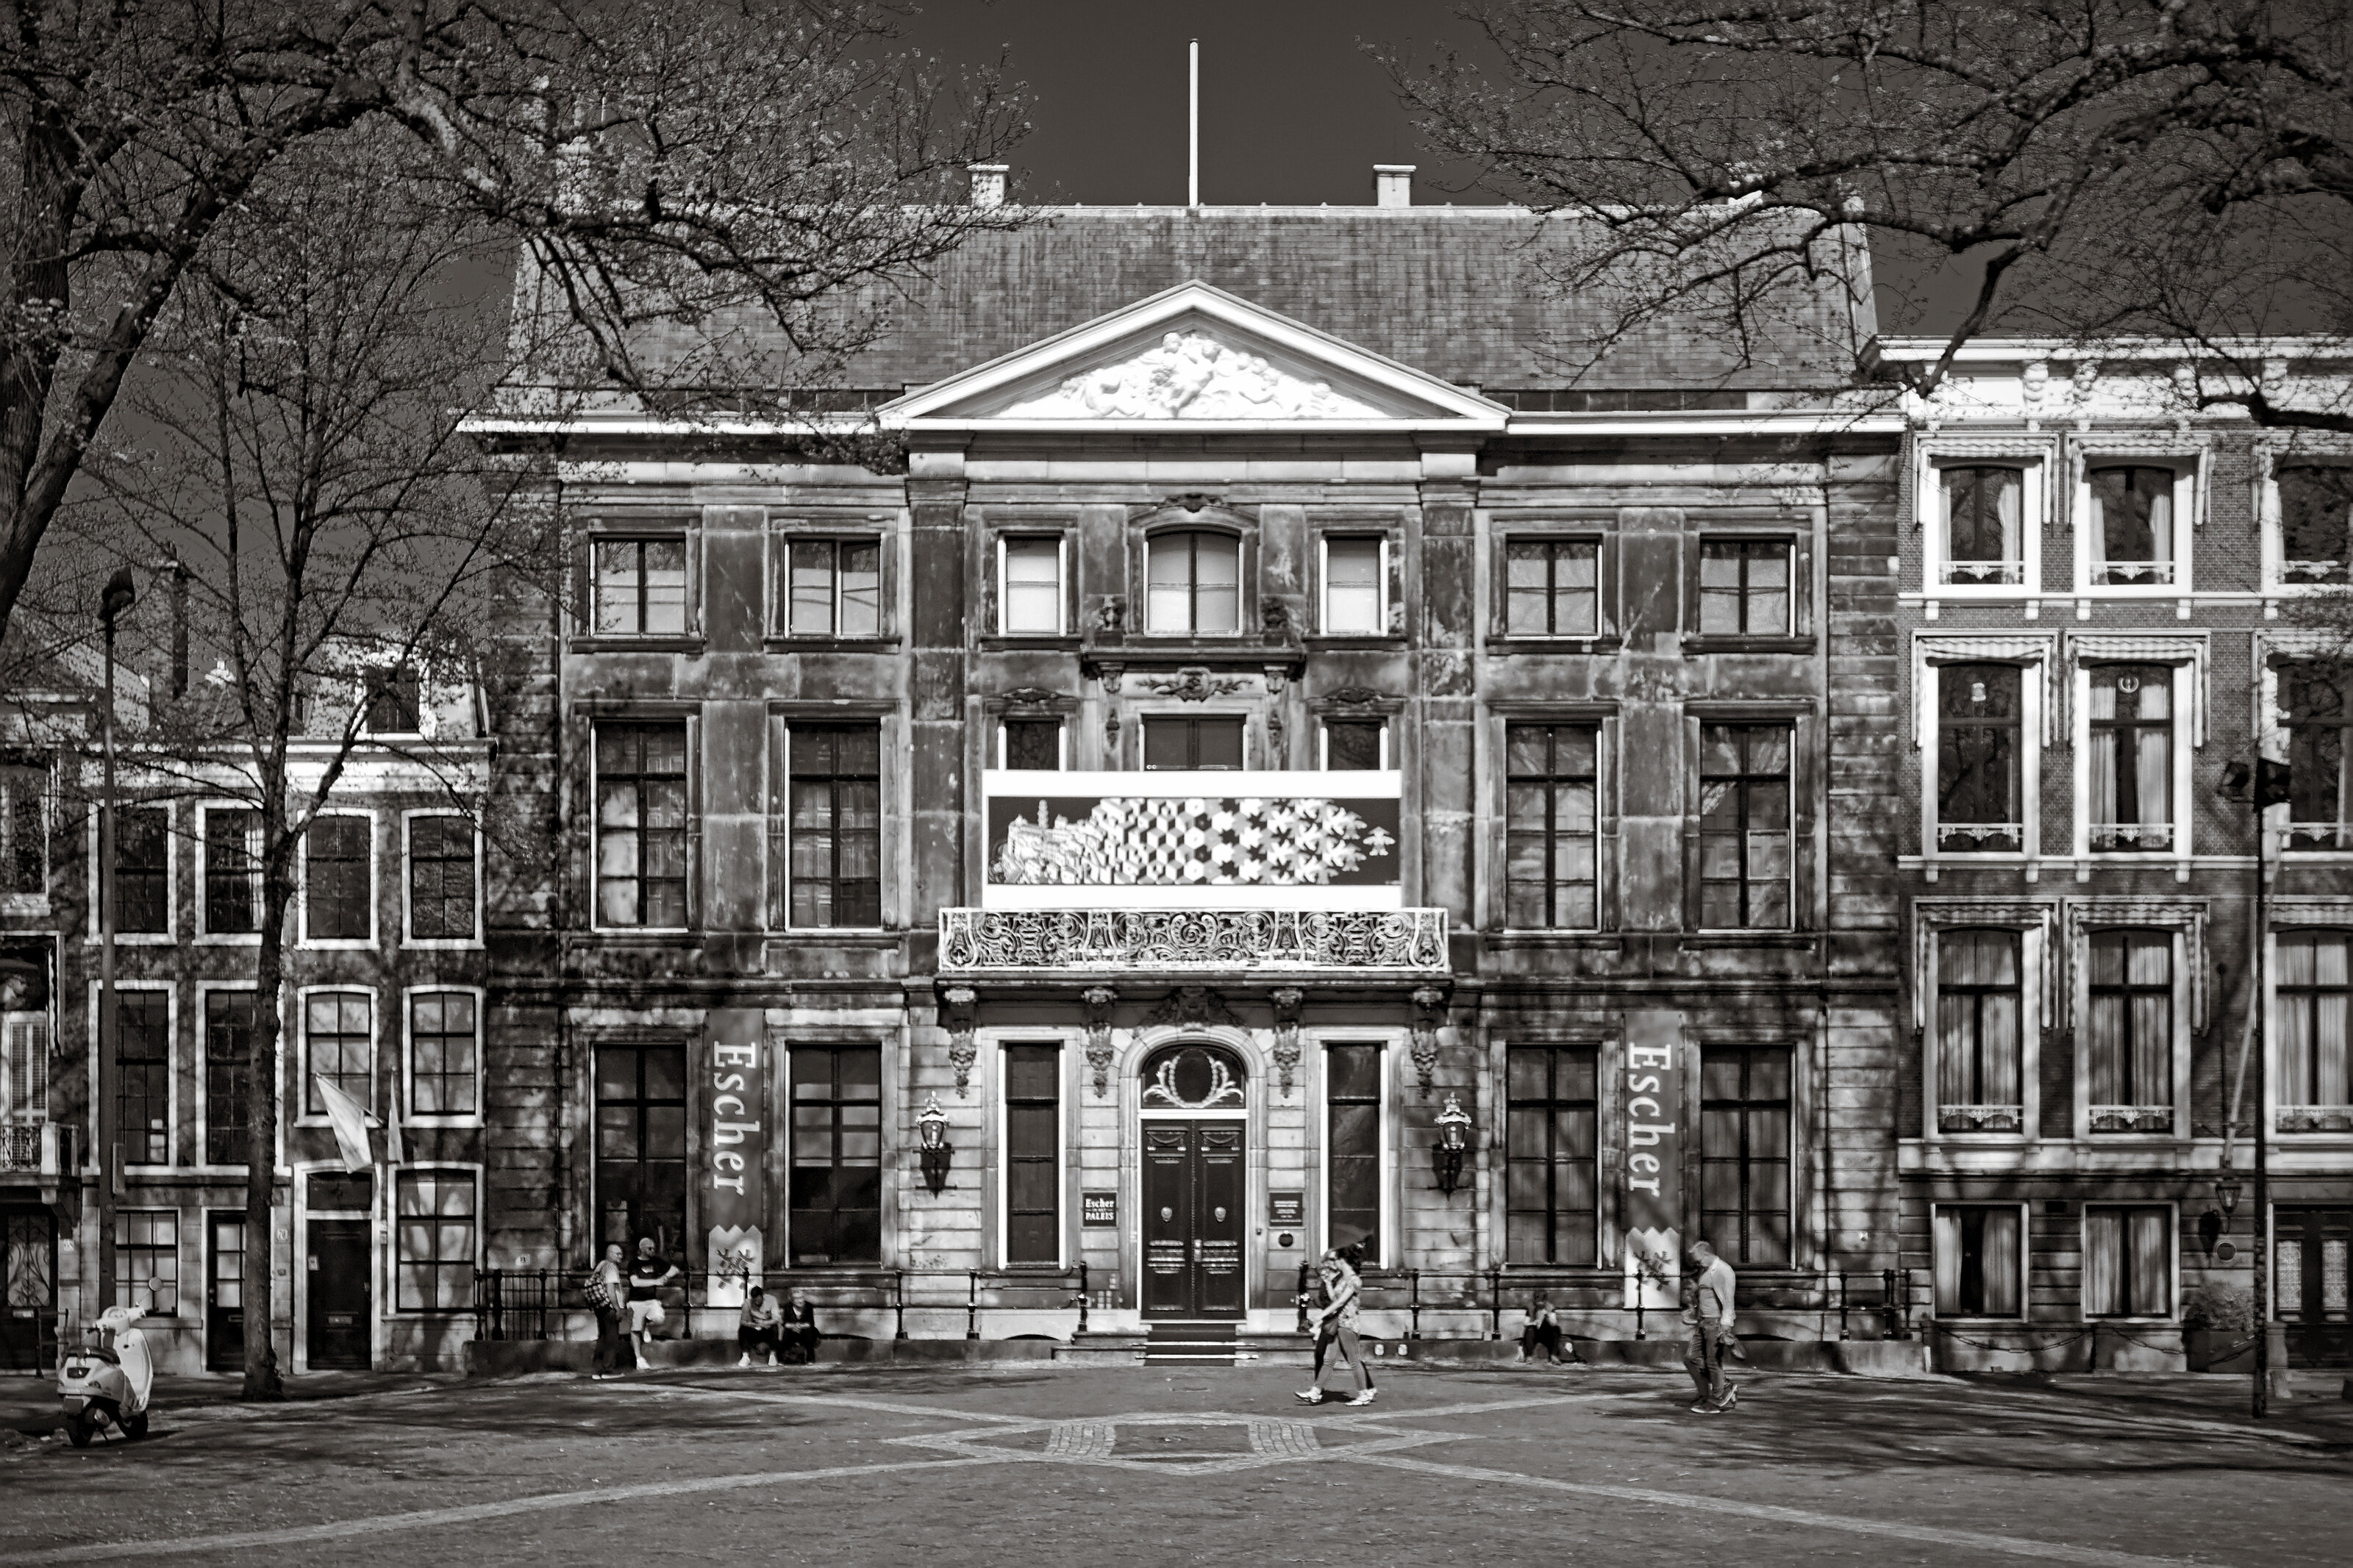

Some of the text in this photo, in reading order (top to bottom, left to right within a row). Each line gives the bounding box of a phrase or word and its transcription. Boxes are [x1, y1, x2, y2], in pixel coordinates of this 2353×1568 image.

[713, 1041, 760, 1196] Escher
[1628, 1042, 1676, 1198] Escher
[1085, 1198, 1114, 1208] Escher
[1085, 1211, 1115, 1220] PALEIS
